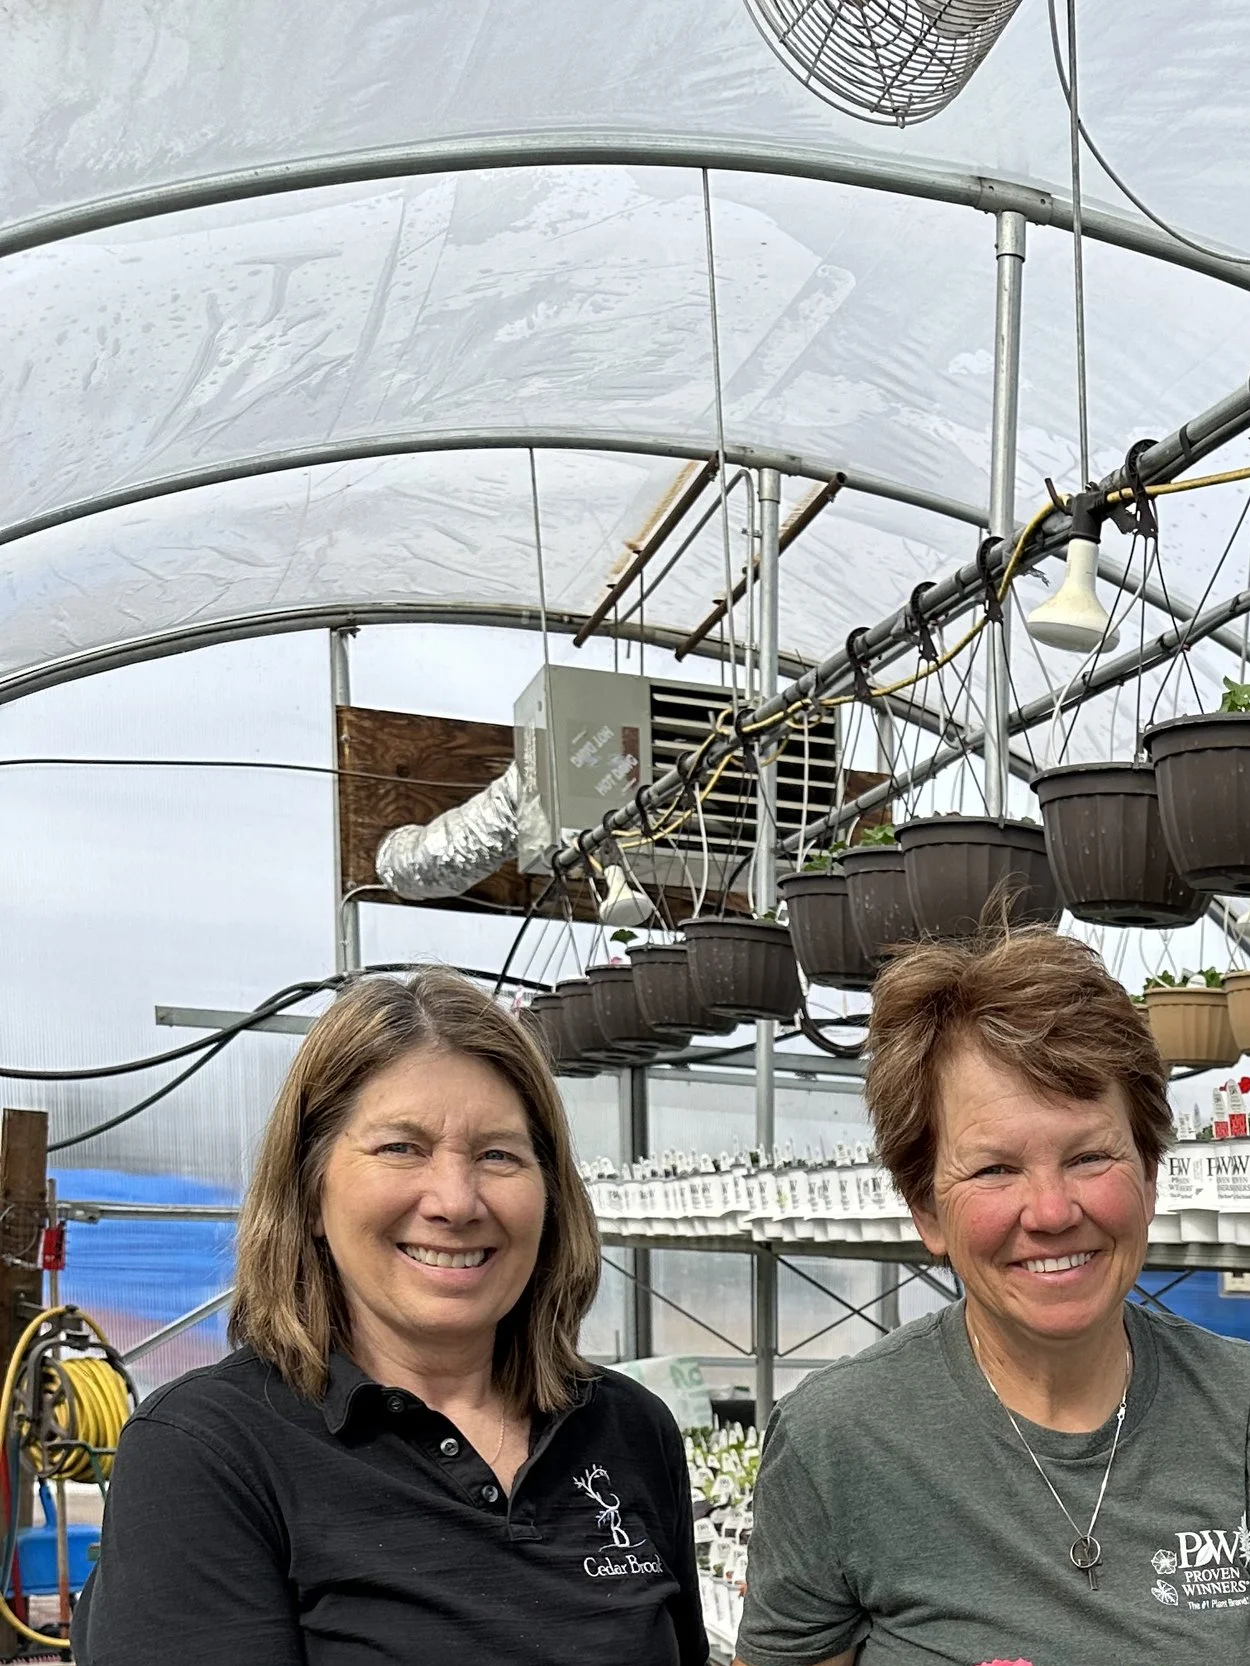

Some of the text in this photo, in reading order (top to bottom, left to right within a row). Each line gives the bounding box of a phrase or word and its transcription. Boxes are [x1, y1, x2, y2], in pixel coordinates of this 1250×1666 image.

[1174, 1530, 1240, 1568] PW
[584, 1556, 627, 1577] Cedar
[1183, 1567, 1240, 1583] PROVEN
[1182, 1580, 1248, 1596] WINNERS
